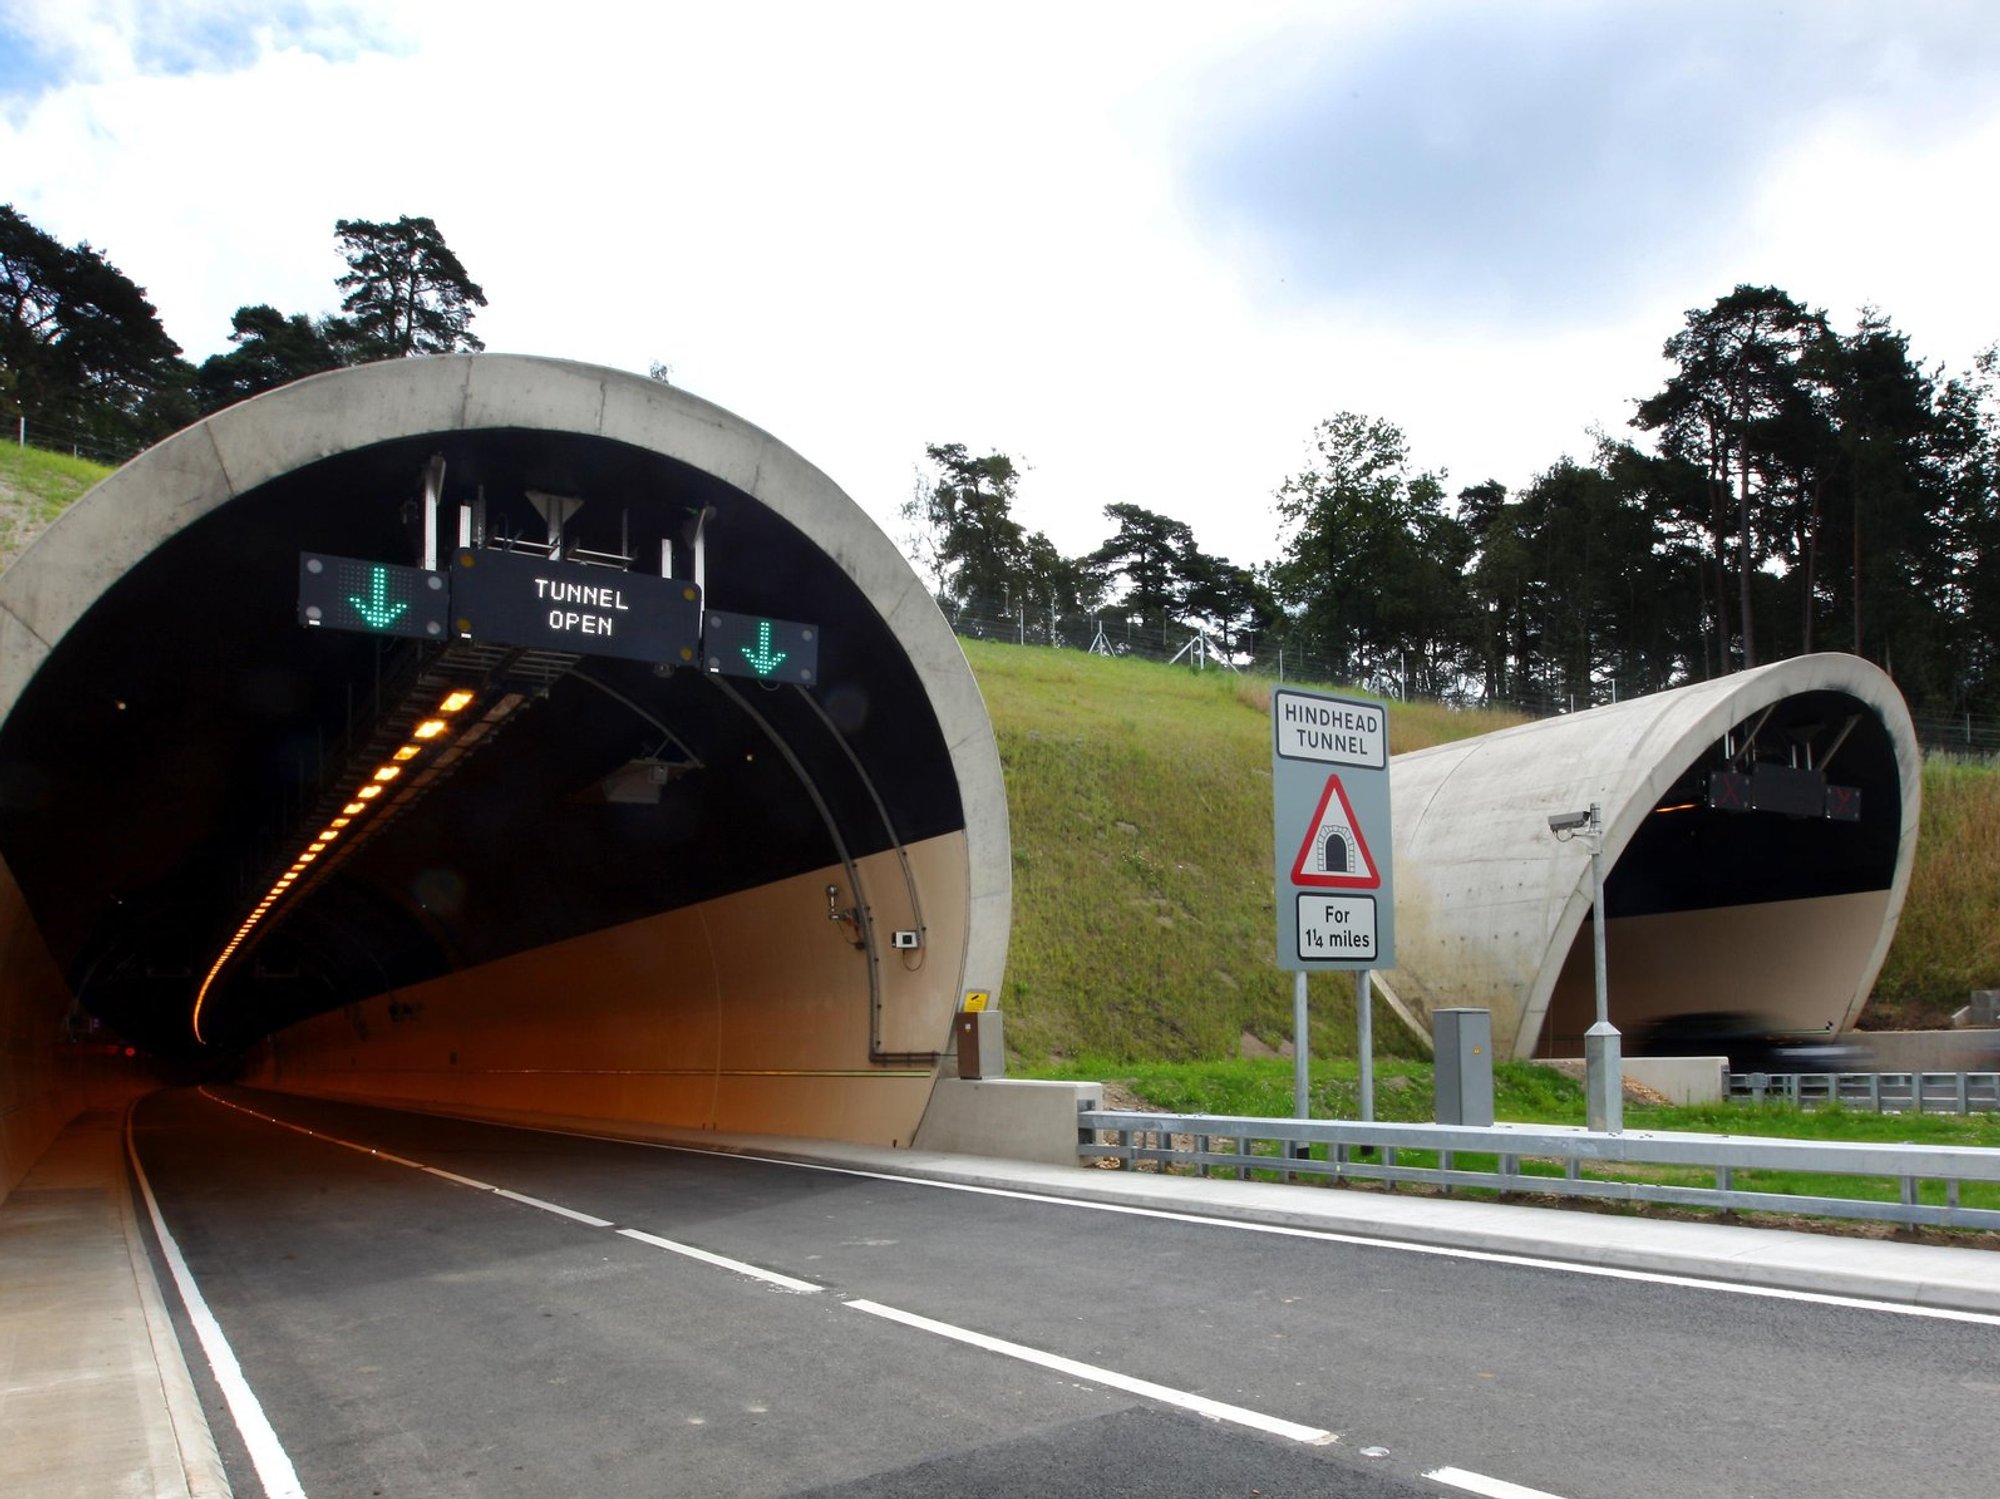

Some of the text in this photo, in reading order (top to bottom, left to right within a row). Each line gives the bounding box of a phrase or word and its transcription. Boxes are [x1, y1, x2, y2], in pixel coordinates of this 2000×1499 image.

[535, 578, 629, 610] TUNNEL
[549, 611, 612, 636] OPEN
[1285, 703, 1378, 733] HINDHEAD
[1296, 729, 1368, 755] TUNNEL
[1325, 905, 1350, 923] For
[1329, 930, 1370, 948] miles
